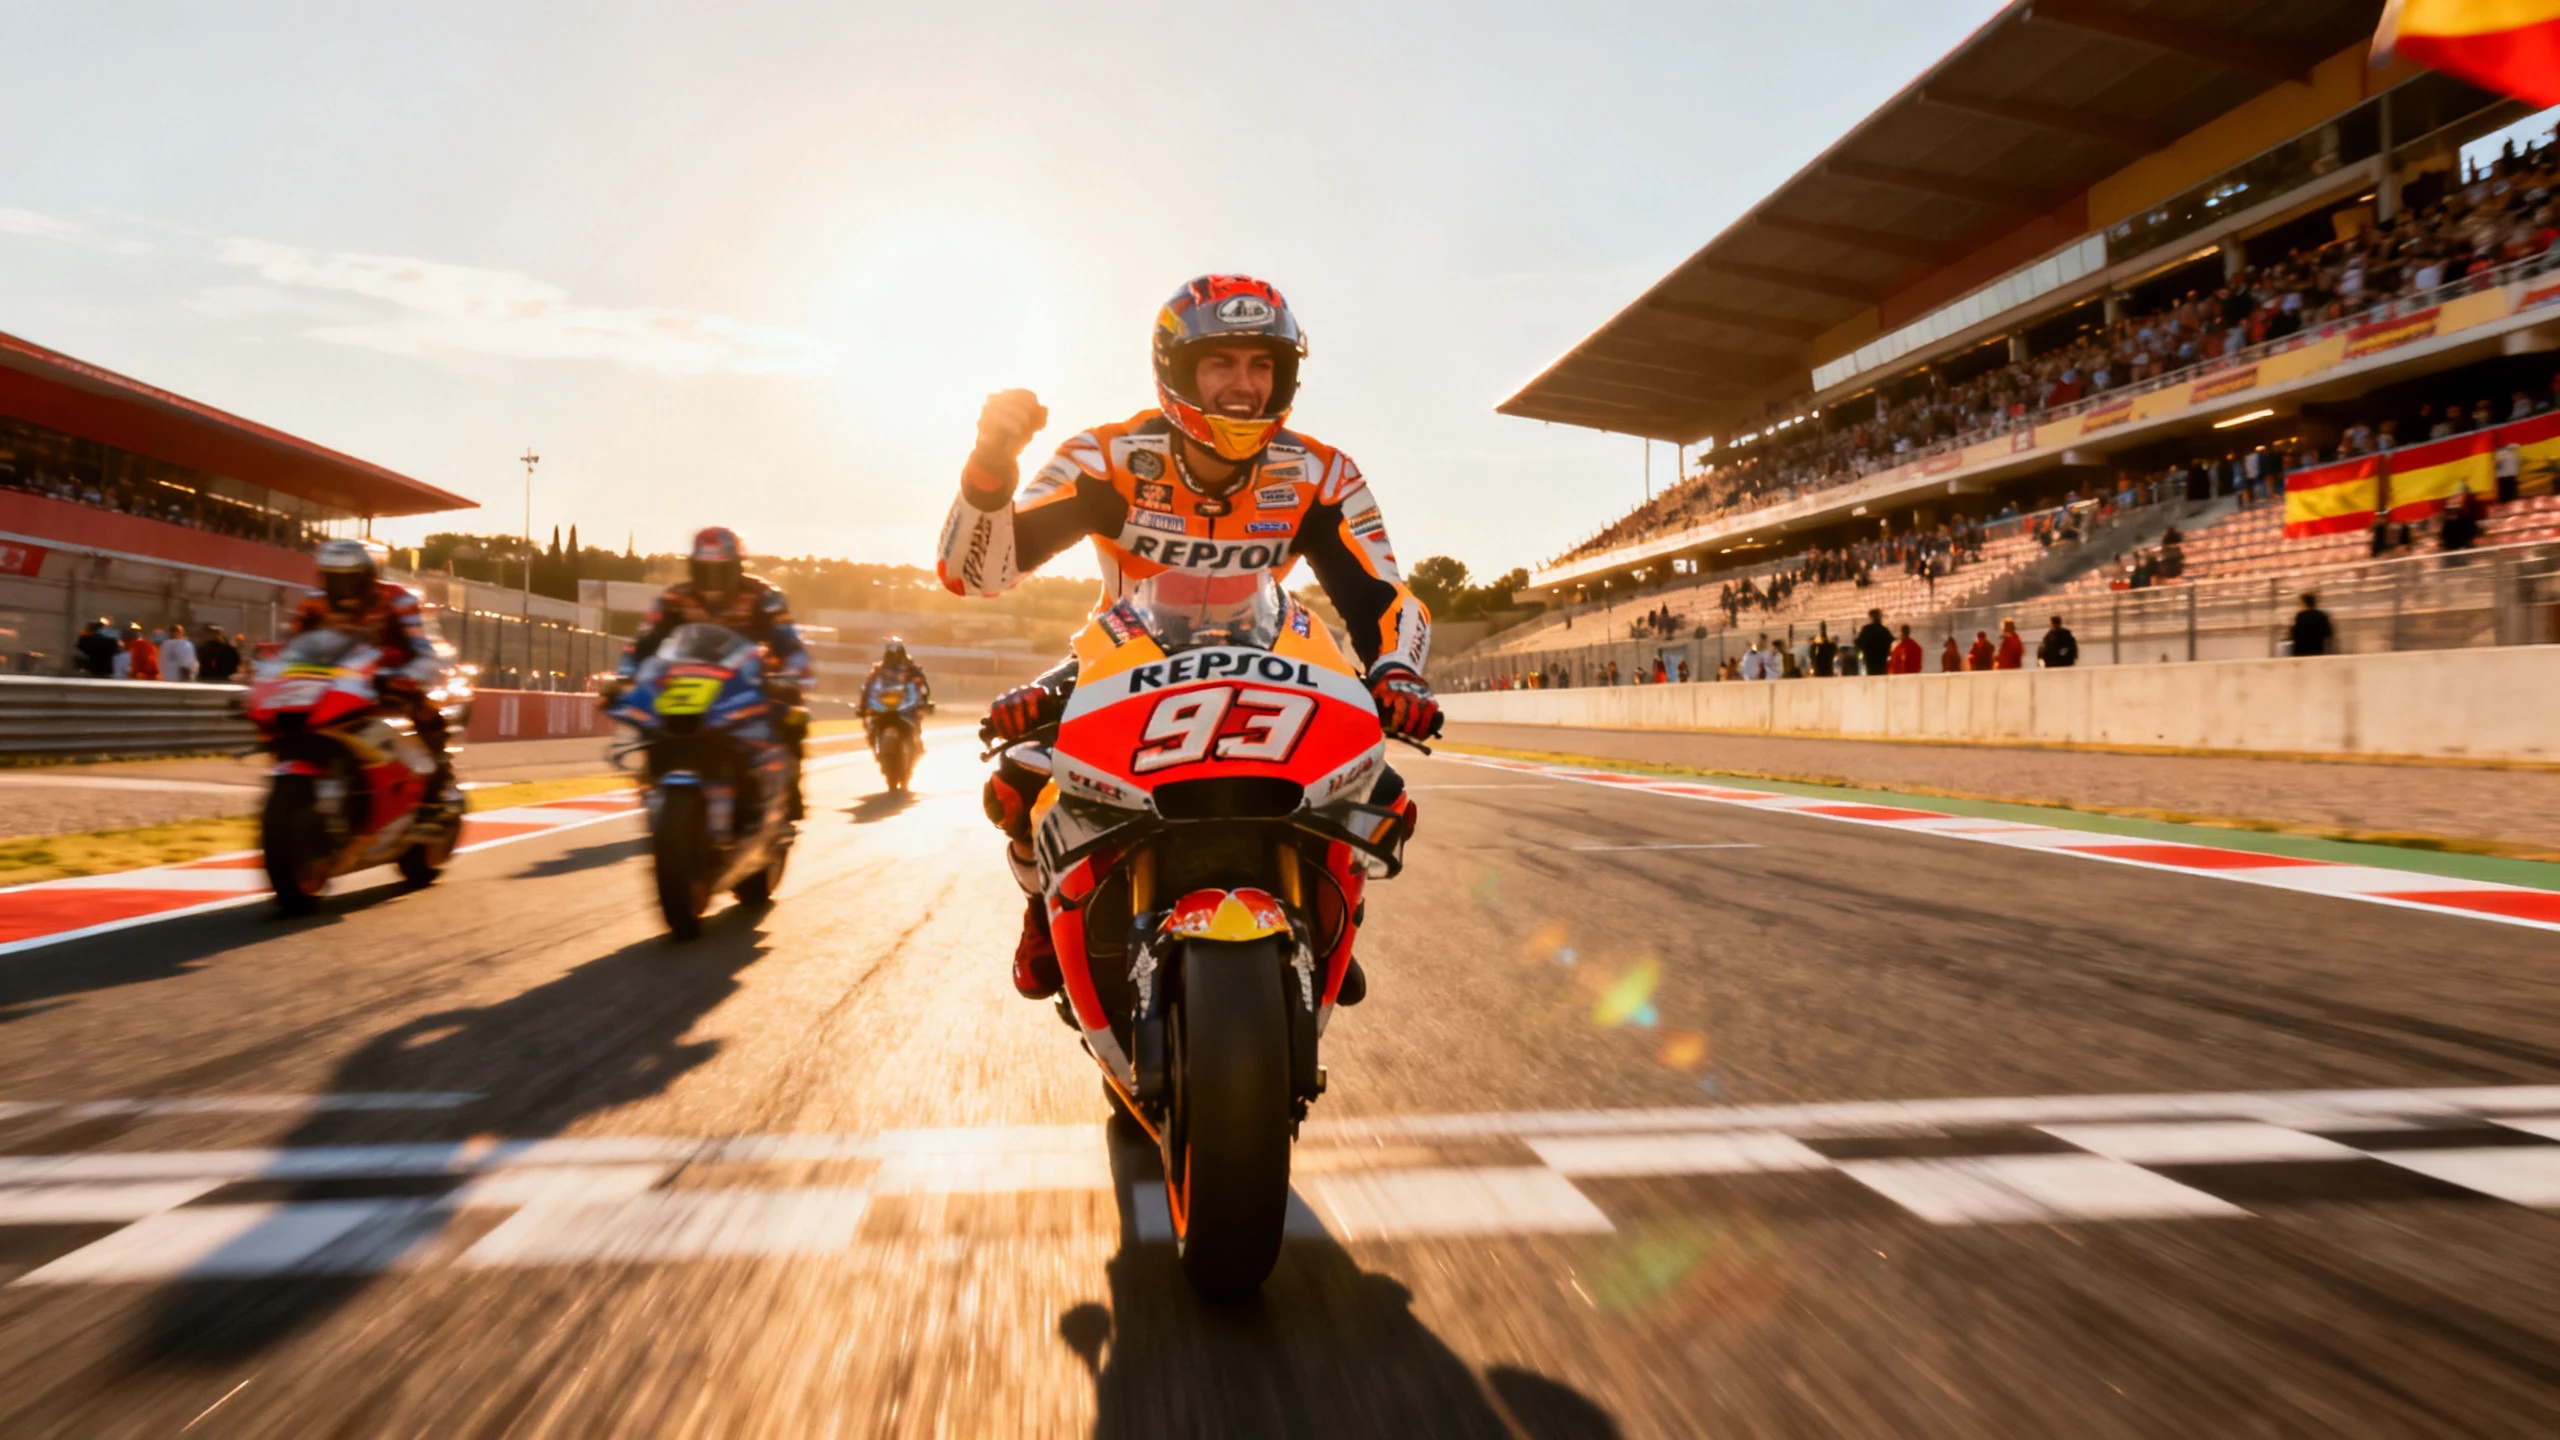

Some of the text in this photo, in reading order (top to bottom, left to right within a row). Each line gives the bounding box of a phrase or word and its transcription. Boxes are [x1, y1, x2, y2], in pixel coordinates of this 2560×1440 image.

[1132, 535, 1284, 568] REPSOL
[1130, 652, 1318, 692] REPSOL
[1131, 685, 1318, 775] 93
